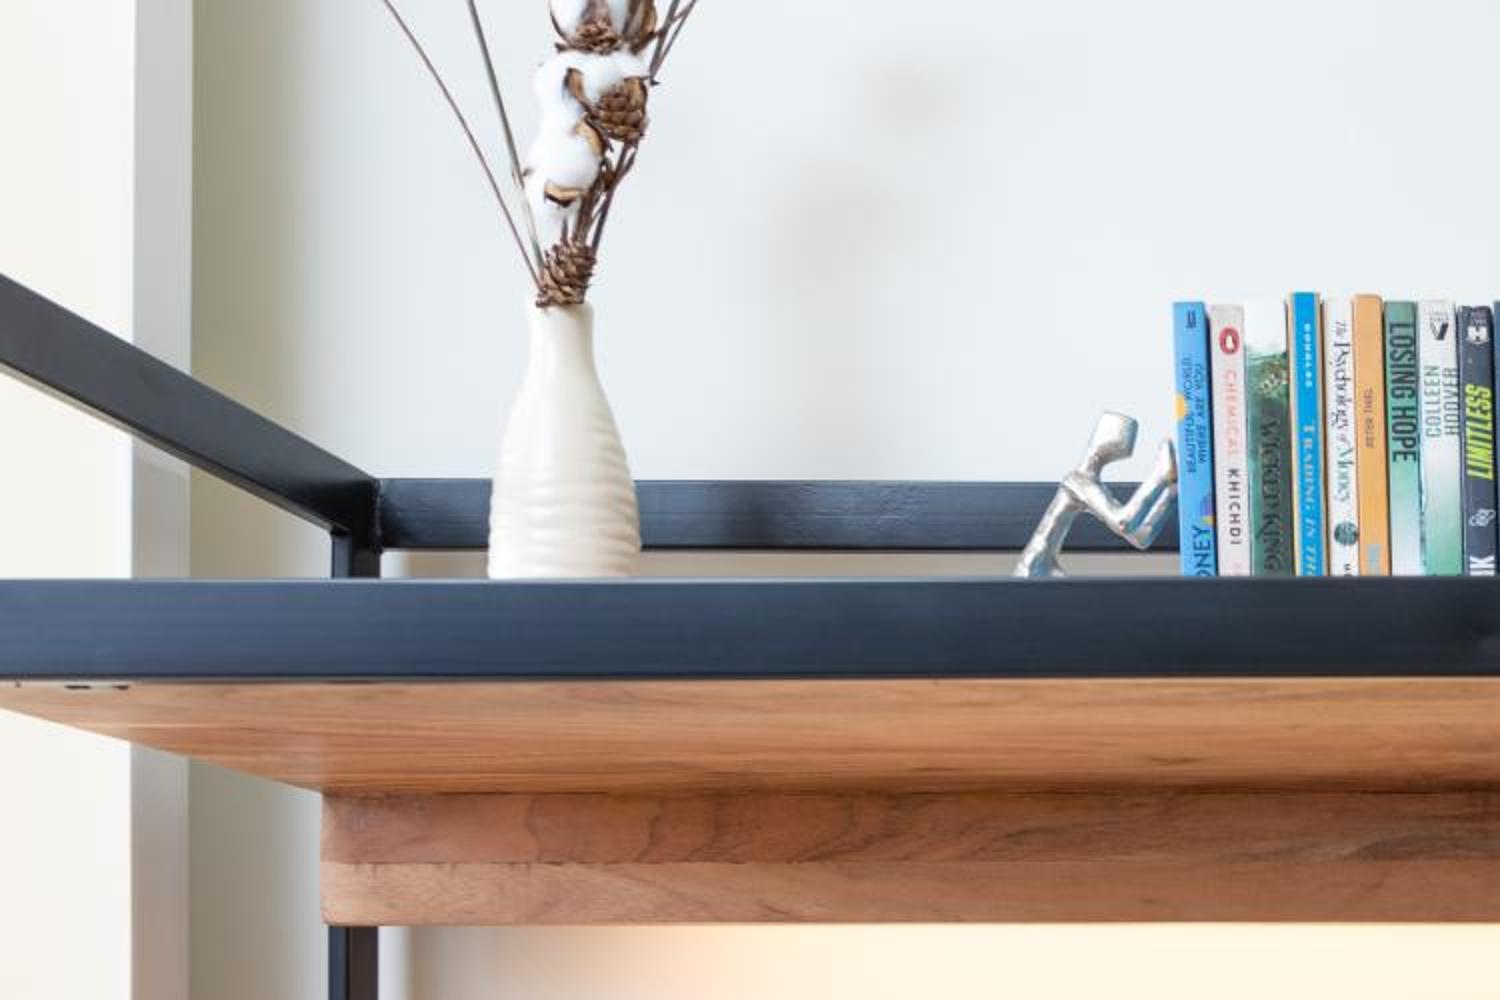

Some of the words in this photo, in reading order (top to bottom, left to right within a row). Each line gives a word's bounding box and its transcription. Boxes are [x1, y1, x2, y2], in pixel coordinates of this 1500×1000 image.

[1328, 343, 1353, 430] Psychology
[1389, 323, 1416, 400] LOSING
[1222, 368, 1239, 456] CHEMICAL
[1391, 407, 1418, 462] HOPE
[1423, 365, 1443, 438] COLLEEN
[1442, 367, 1460, 437] HOOVER
[1464, 383, 1494, 480] LIMITLESS
[1227, 468, 1242, 545] KHICHDI
[1258, 511, 1283, 573] KING
